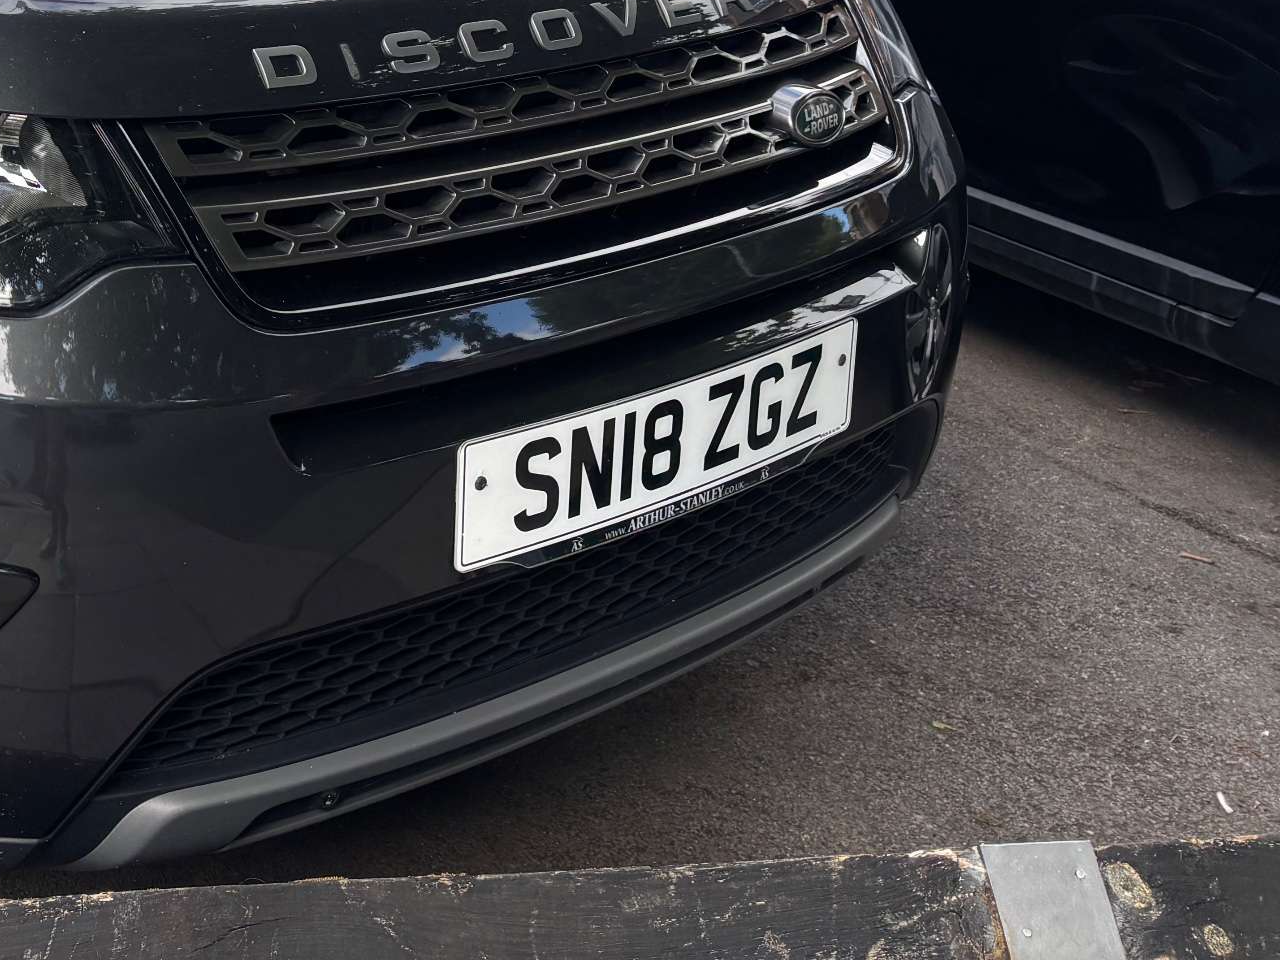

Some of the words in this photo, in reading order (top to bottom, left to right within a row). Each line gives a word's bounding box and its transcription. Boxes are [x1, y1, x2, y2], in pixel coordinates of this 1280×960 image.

[804, 102, 830, 122] LAND
[810, 112, 839, 135] ROVER
[513, 398, 685, 533] SN18
[703, 343, 823, 472] ZGZ
